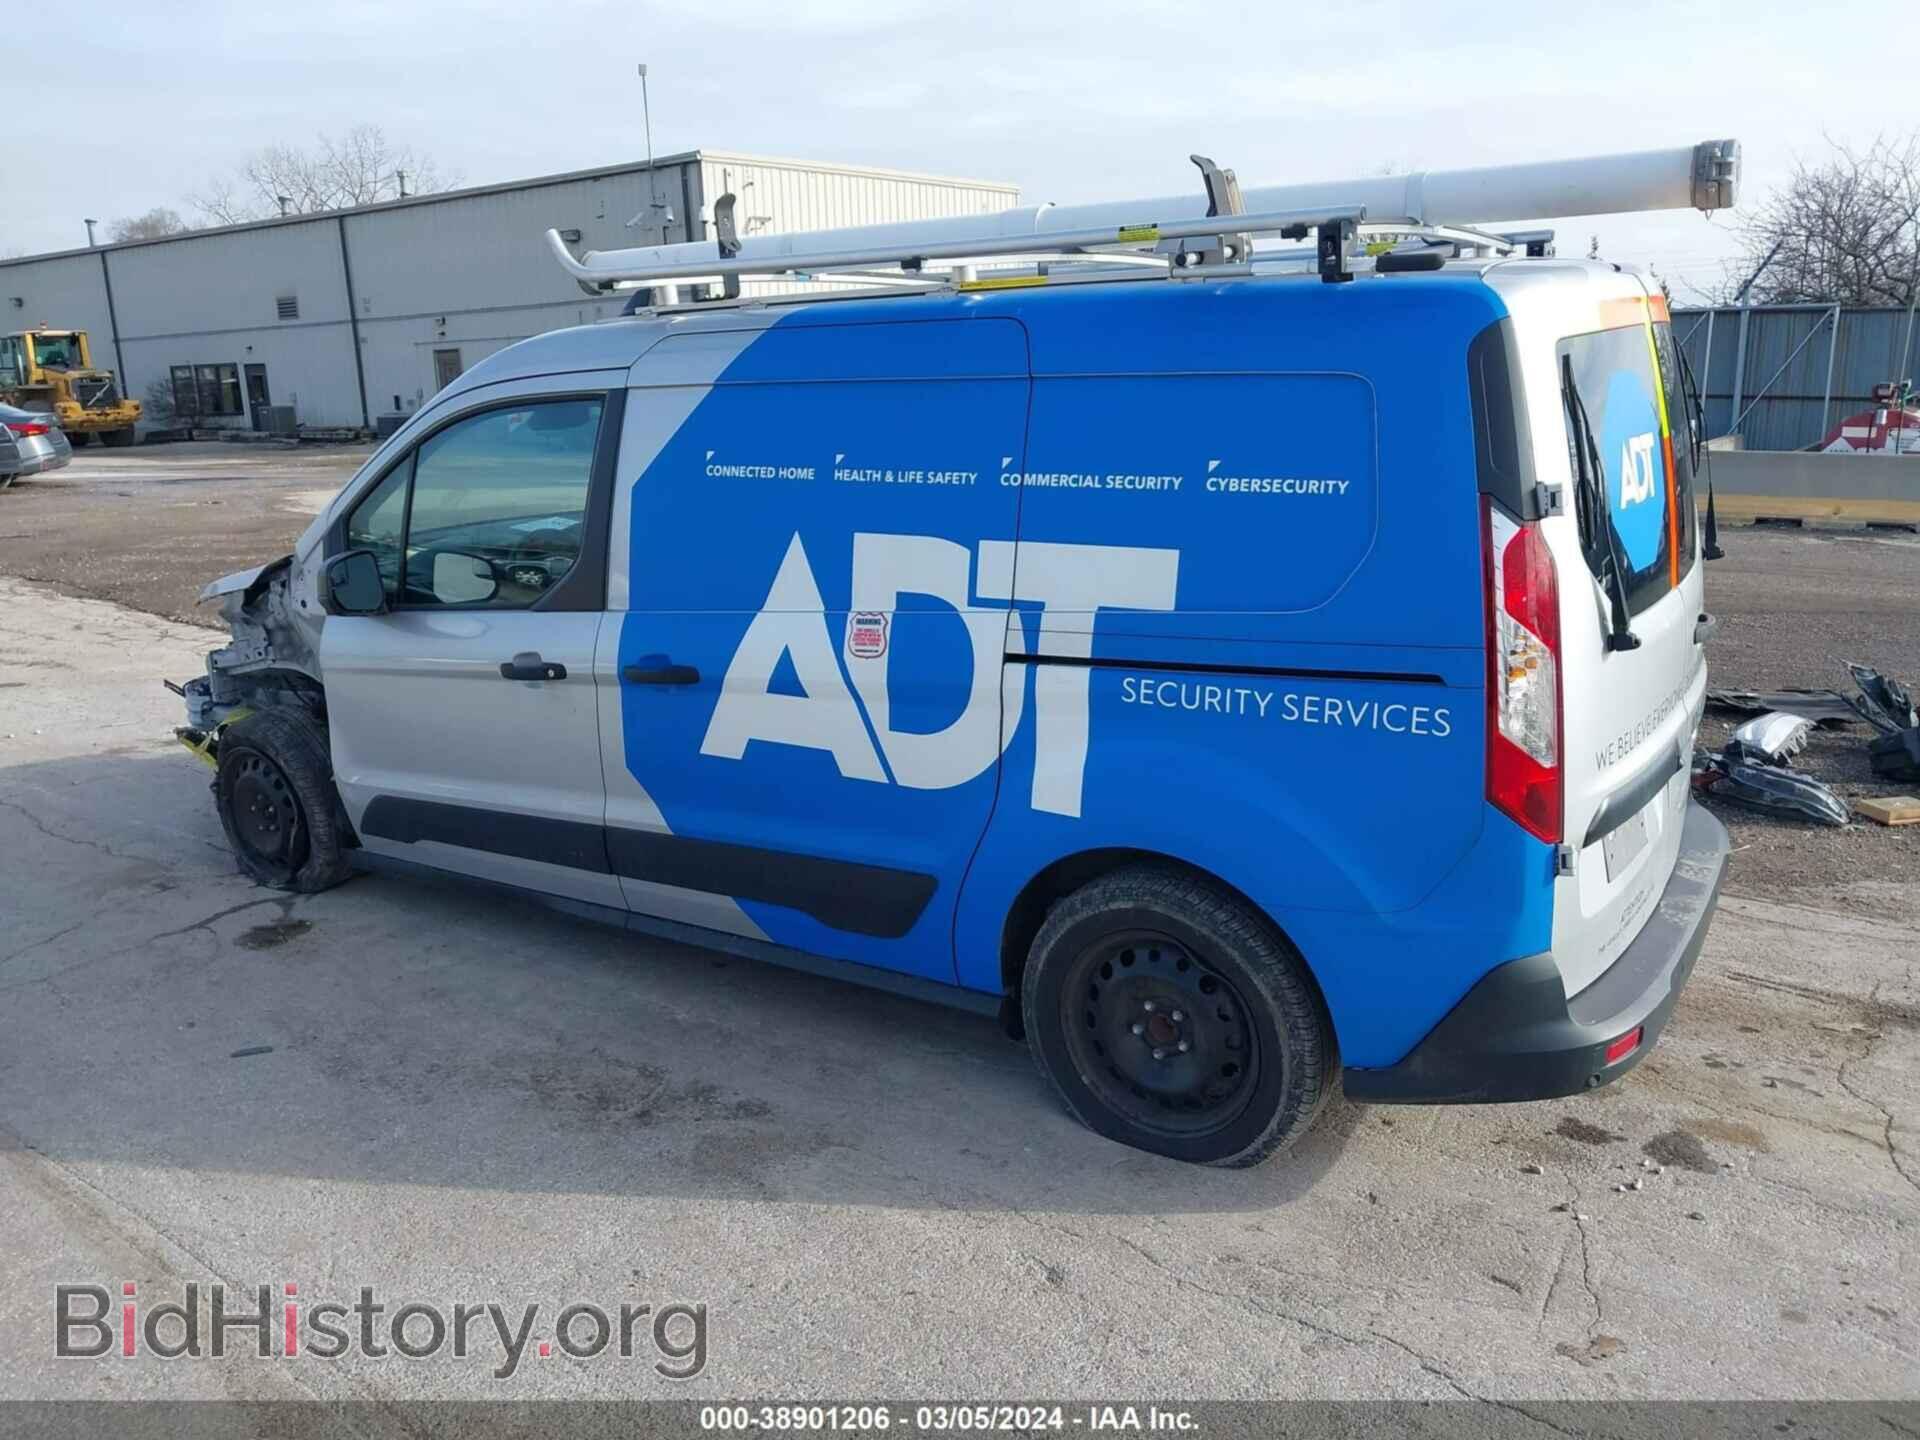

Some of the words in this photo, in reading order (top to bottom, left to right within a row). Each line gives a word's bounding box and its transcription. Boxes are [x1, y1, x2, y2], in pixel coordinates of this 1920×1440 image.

[705, 464, 776, 479] CONNECTED
[778, 466, 816, 480] HOME
[834, 468, 882, 483] HEALTH
[884, 471, 895, 483] &
[898, 470, 925, 484] LIFE
[927, 471, 979, 486] SAFETY
[1000, 473, 1102, 488] COMMERCIAL
[1105, 475, 1184, 491] SECURITY
[1620, 432, 1655, 510] ADT
[1205, 477, 1350, 496] CYBERSECURITY
[699, 530, 1180, 818] ADT
[1121, 677, 1274, 717] SECURITY
[1281, 694, 1452, 737] SERVICES
[1595, 742, 1616, 771] WE
